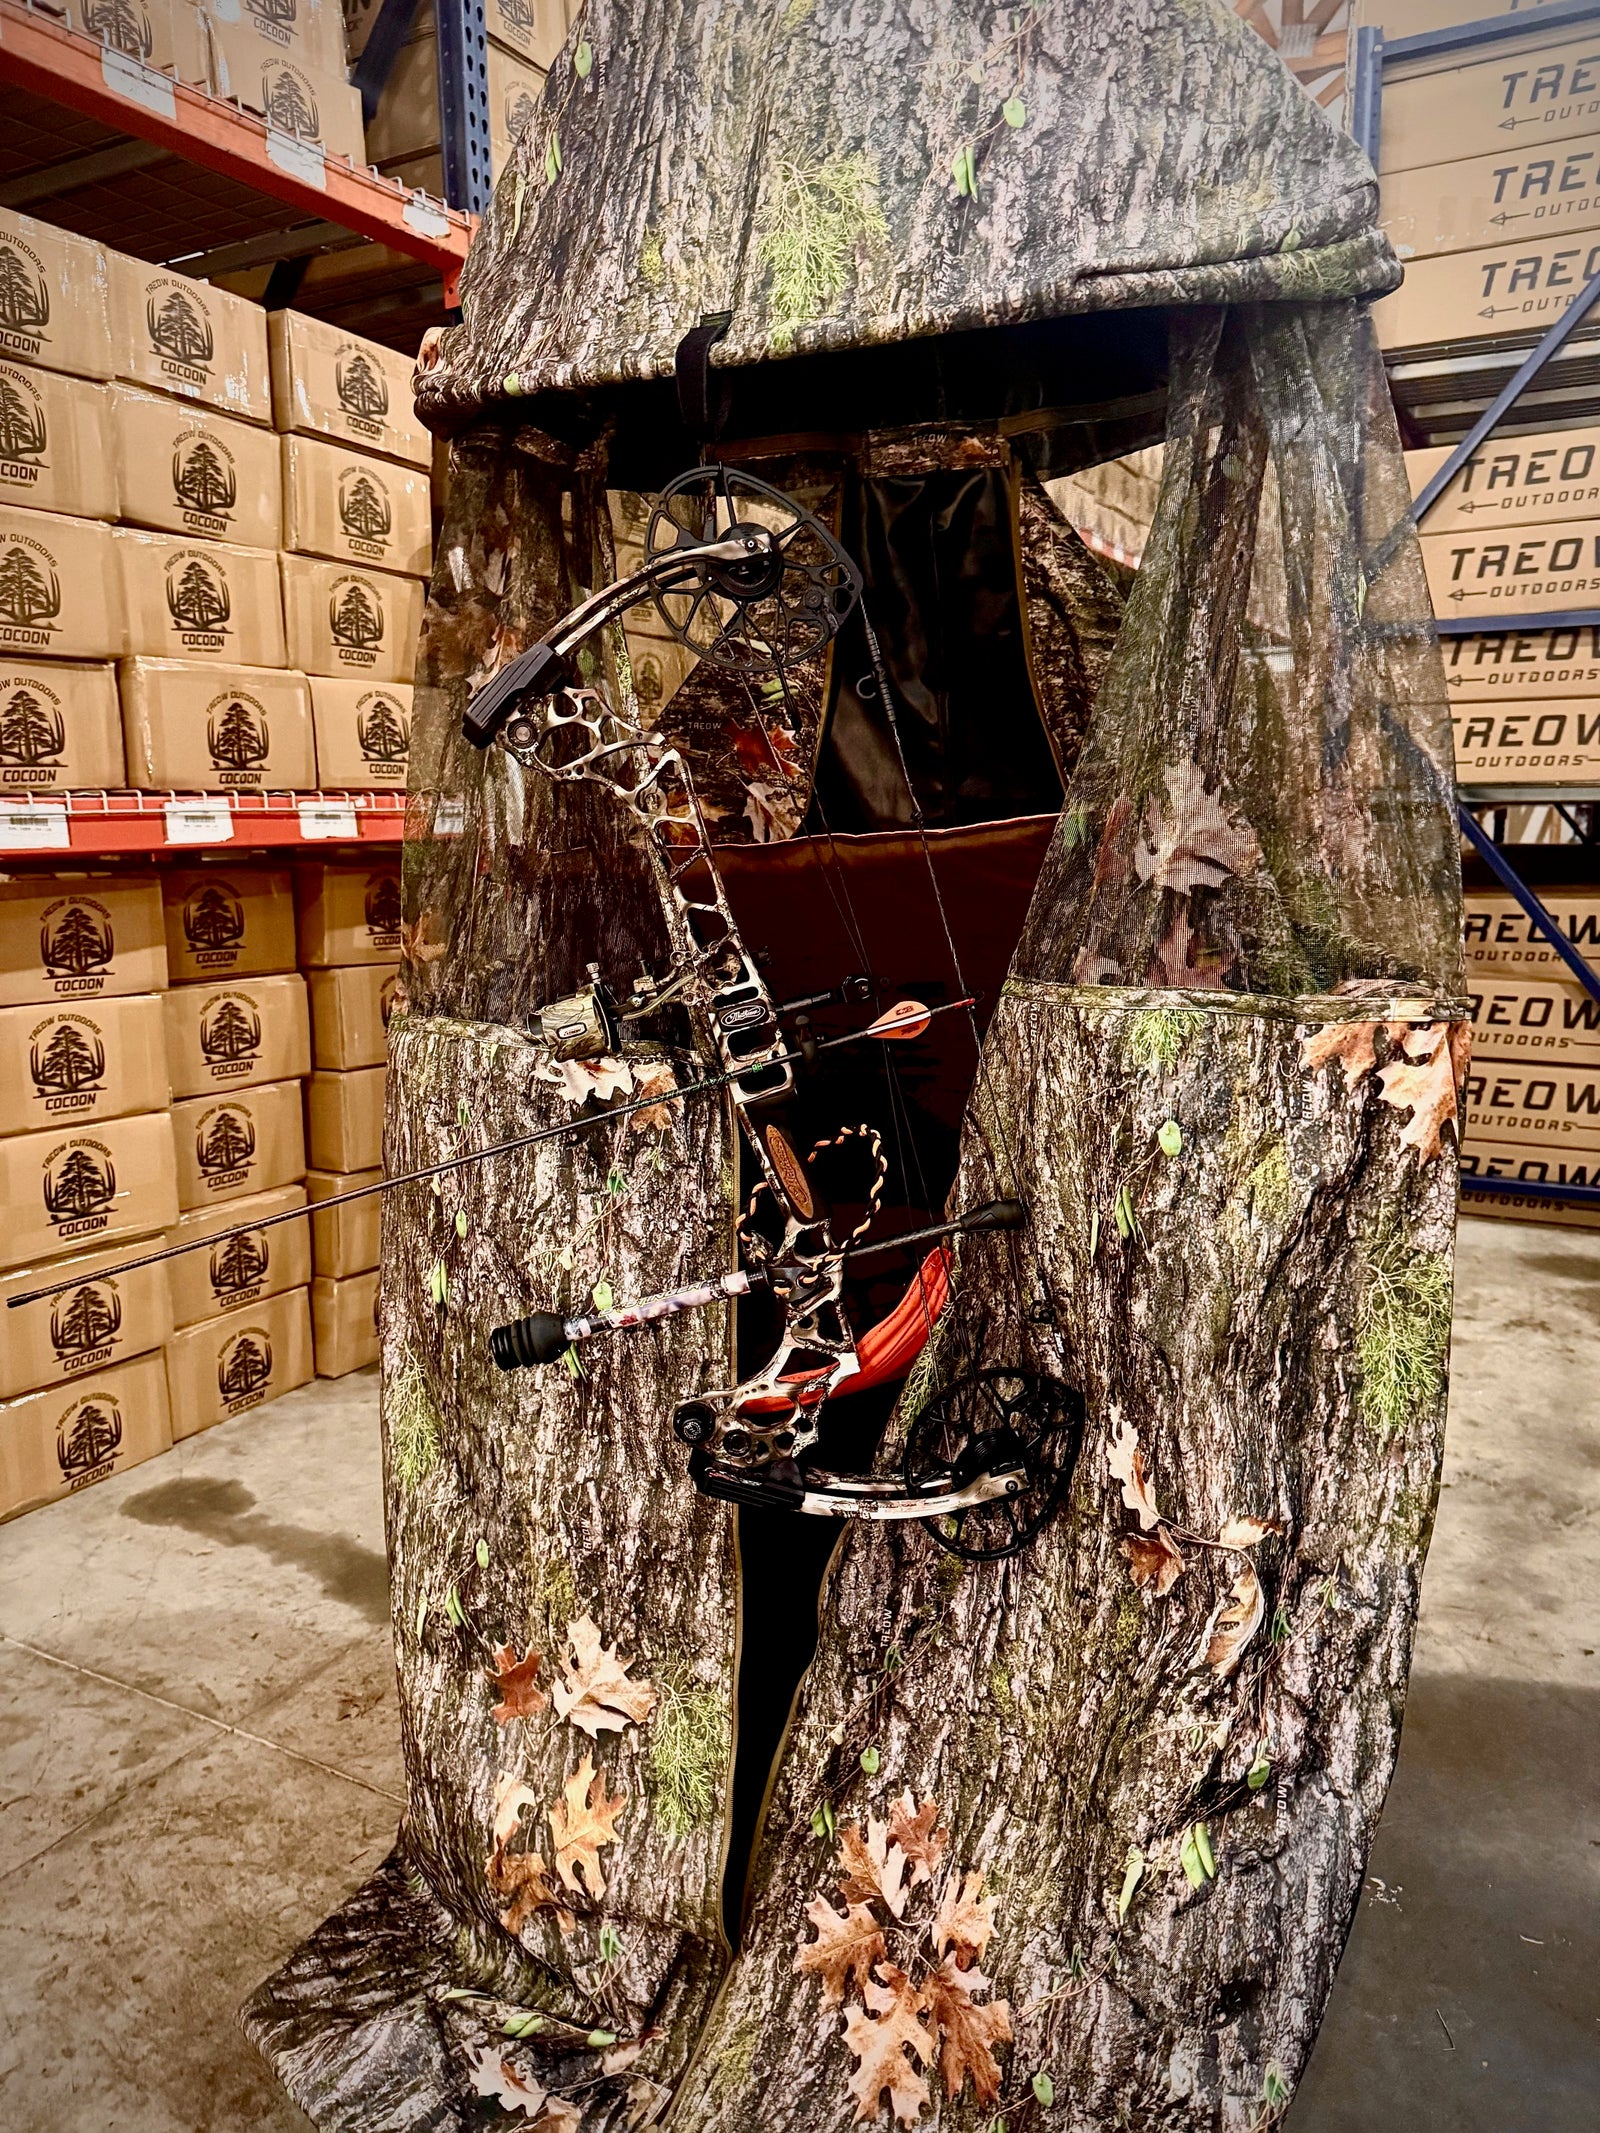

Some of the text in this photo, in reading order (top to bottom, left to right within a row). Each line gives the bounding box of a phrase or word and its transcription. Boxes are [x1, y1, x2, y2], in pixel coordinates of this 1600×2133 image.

[253, 16, 290, 45] COCOON
[1502, 56, 1600, 109] TRE
[1544, 100, 1600, 123] OUTD
[1493, 152, 1600, 204] TRE
[1533, 196, 1600, 219] OUTDO
[1481, 246, 1600, 298] TREO
[145, 278, 211, 317] TREOW OUTDOORS
[0, 330, 40, 354] OCOON
[0, 365, 42, 401] UTDOORS
[160, 360, 207, 385] COCOON
[346, 416, 384, 437] COCOON
[198, 430, 236, 465] OUTDOORS
[0, 463, 38, 482] COON
[1462, 445, 1595, 492] TREO
[1501, 488, 1600, 509] OUTDOOR
[183, 511, 228, 533] COCOON
[10, 533, 58, 569] OUTDOORS
[349, 538, 386, 557] COCOON
[1451, 538, 1600, 581] TREO
[188, 550, 228, 578] OUTDOORS
[1490, 578, 1600, 597] OUTDOORS
[182, 633, 225, 648] COCOON
[1450, 630, 1600, 667] TREO
[337, 648, 376, 665] COCOON
[1487, 668, 1598, 685] OUTDOORS
[14, 677, 62, 707] OUTDOORS
[230, 691, 267, 717] OUTDOORS
[687, 721, 723, 730] TREOW
[369, 764, 405, 775] COCOON
[1475, 755, 1583, 769] OUTDOORS
[2, 770, 57, 782] COCOON
[219, 773, 262, 785] COCOON
[68, 896, 112, 920] OUTDOORS
[373, 935, 402, 946] COCOO
[1464, 913, 1600, 945] REOW
[195, 951, 238, 965] COCOON
[1474, 951, 1562, 963] OUTDOOR
[54, 978, 105, 993] COCOON
[1469, 994, 1600, 1031] REOW
[29, 1014, 103, 1042] TREOW OUTDOORS
[211, 1061, 254, 1077] COCOON
[45, 1093, 97, 1111] COCOON
[1466, 1076, 1600, 1114] REOW
[1468, 1113, 1573, 1132] OUTDOORS
[42, 1139, 113, 1170] TREOW OUTDOORS
[207, 1170, 249, 1188] COCOON
[1460, 1155, 1600, 1186] REOW
[58, 1215, 108, 1238] COCOON
[219, 1286, 262, 1308] COCOON
[63, 1347, 113, 1373] COCOON
[228, 1389, 266, 1414] COCOON
[70, 1461, 115, 1491] COCOON
[880, 1609, 892, 1647] TREOW
